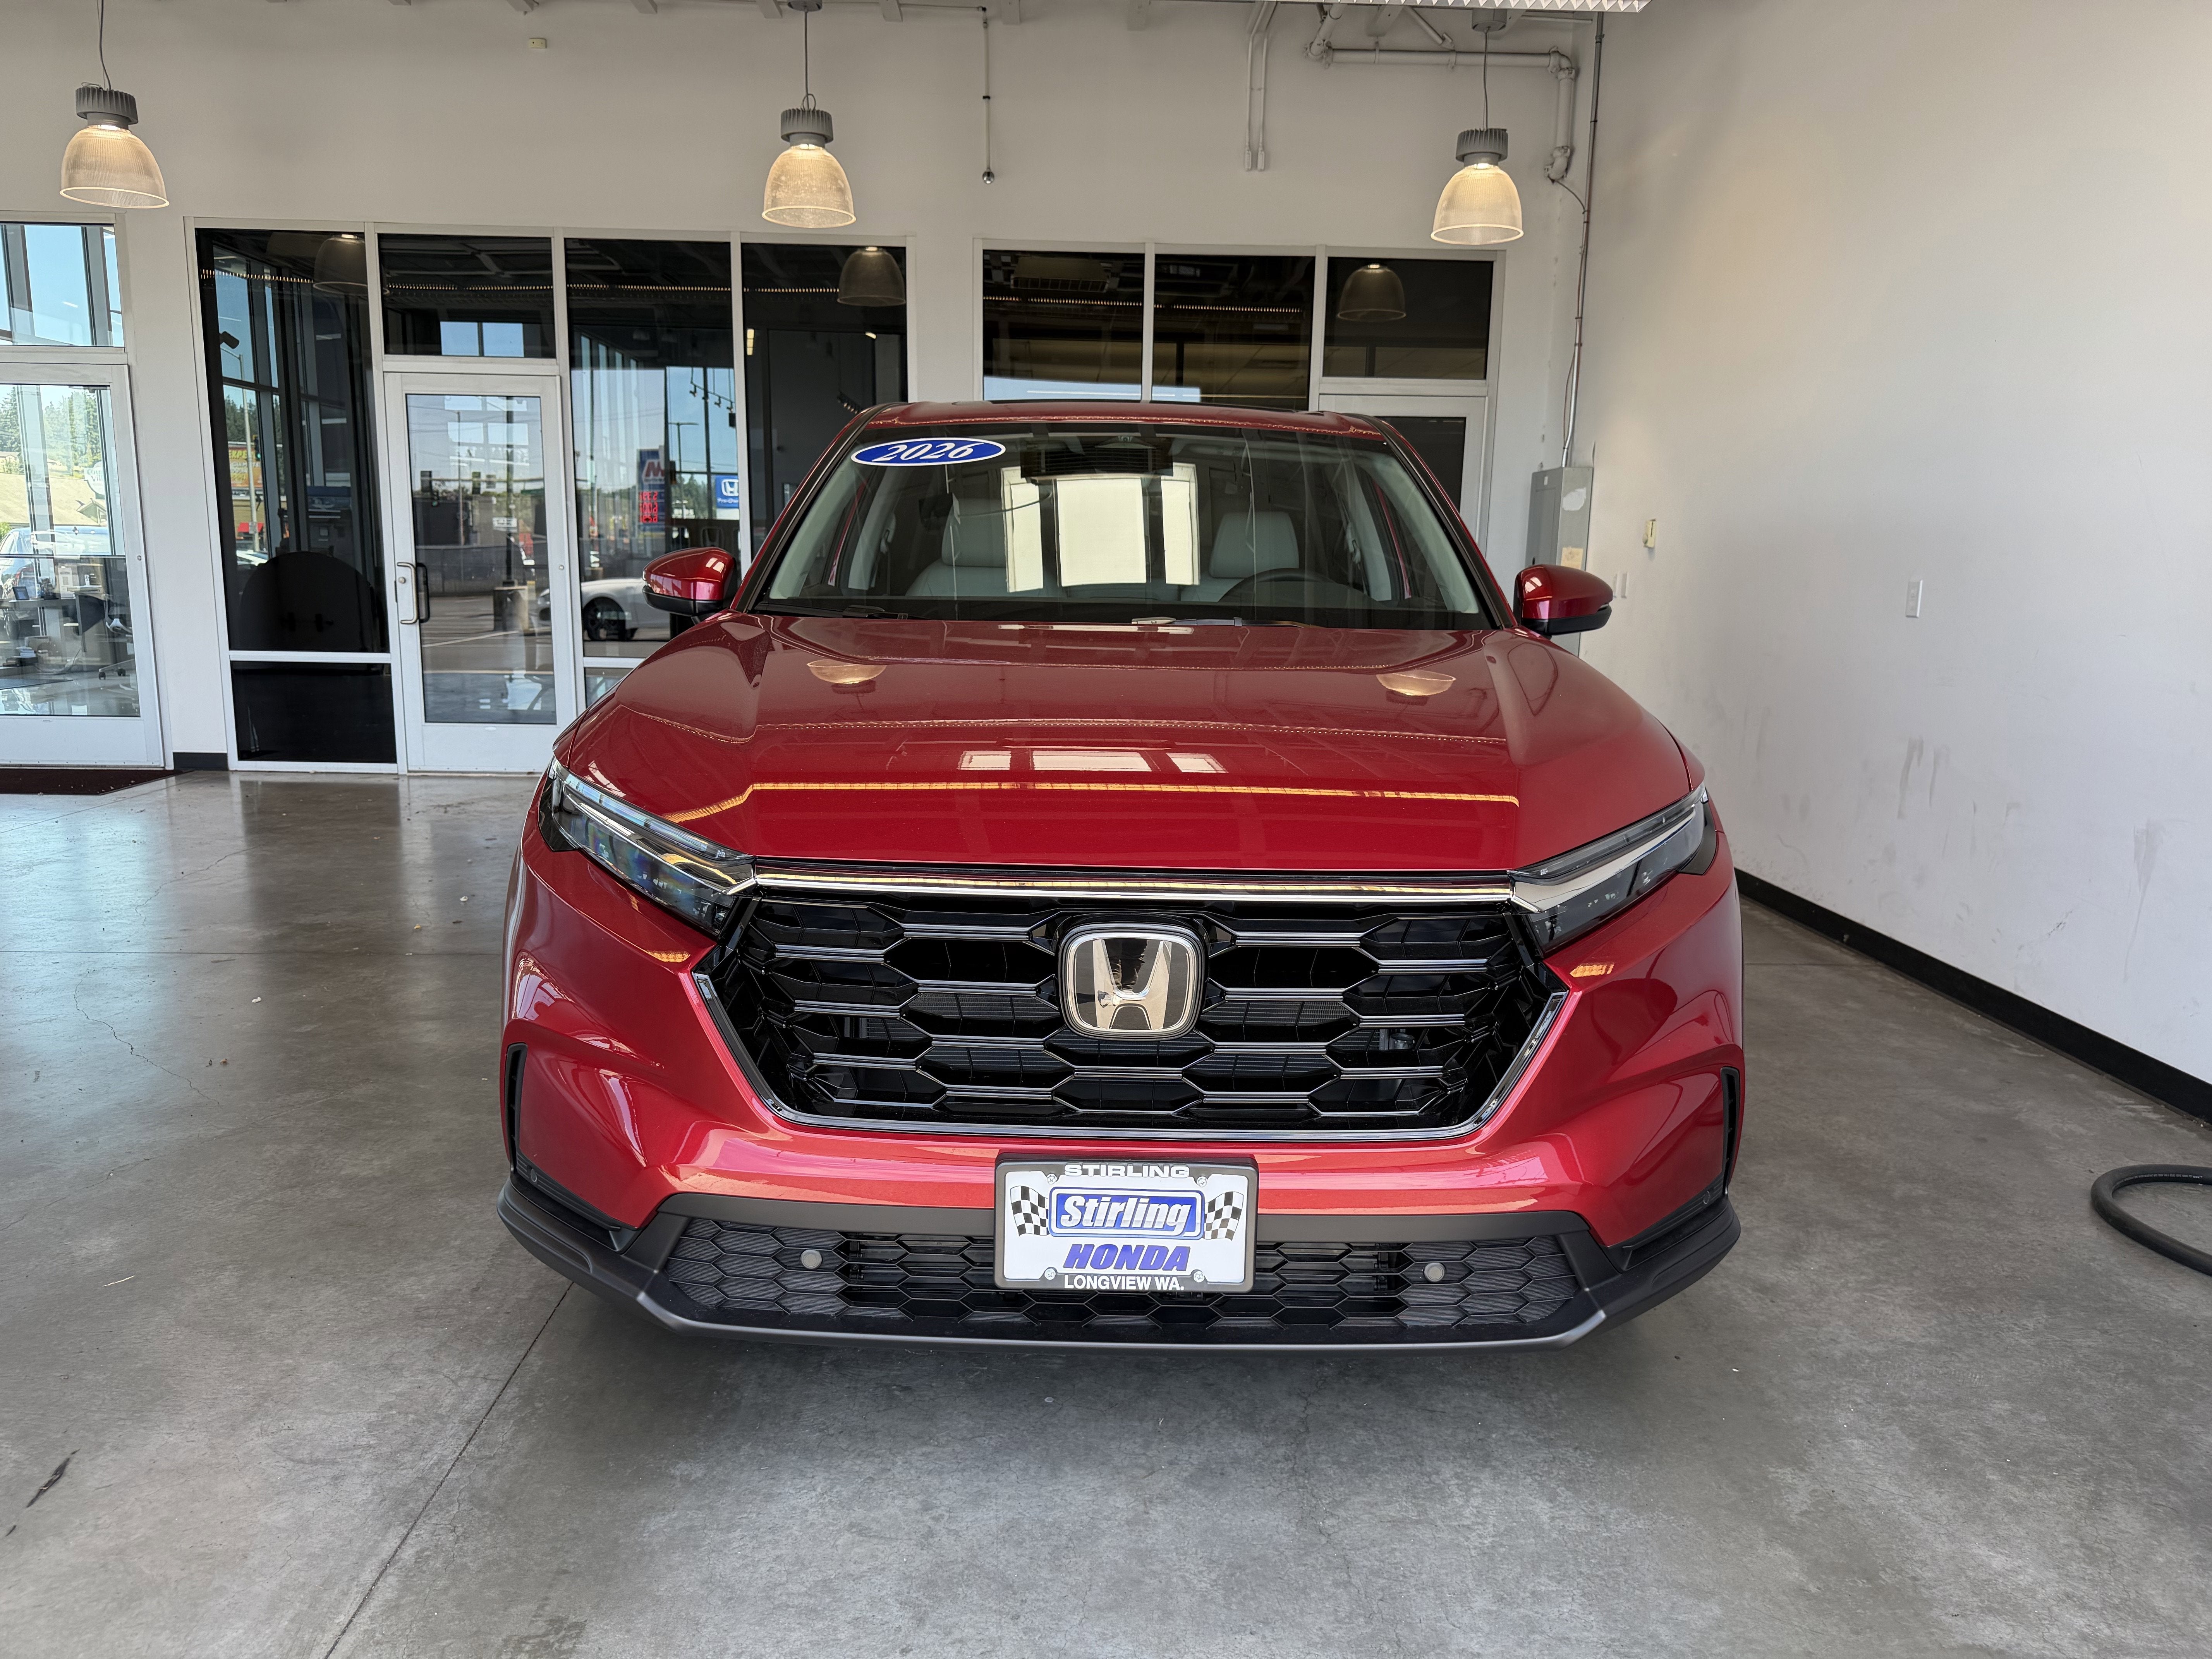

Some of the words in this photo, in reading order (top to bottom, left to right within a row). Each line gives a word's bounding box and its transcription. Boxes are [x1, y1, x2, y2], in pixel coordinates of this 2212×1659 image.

[872, 443, 984, 462] 2026
[1064, 1163, 1190, 1178] STIRLING
[1060, 1195, 1192, 1236] Stirling
[1063, 1243, 1191, 1271] HONDA
[1064, 1275, 1152, 1290] LONGVIEW
[1154, 1276, 1184, 1290] WA.
